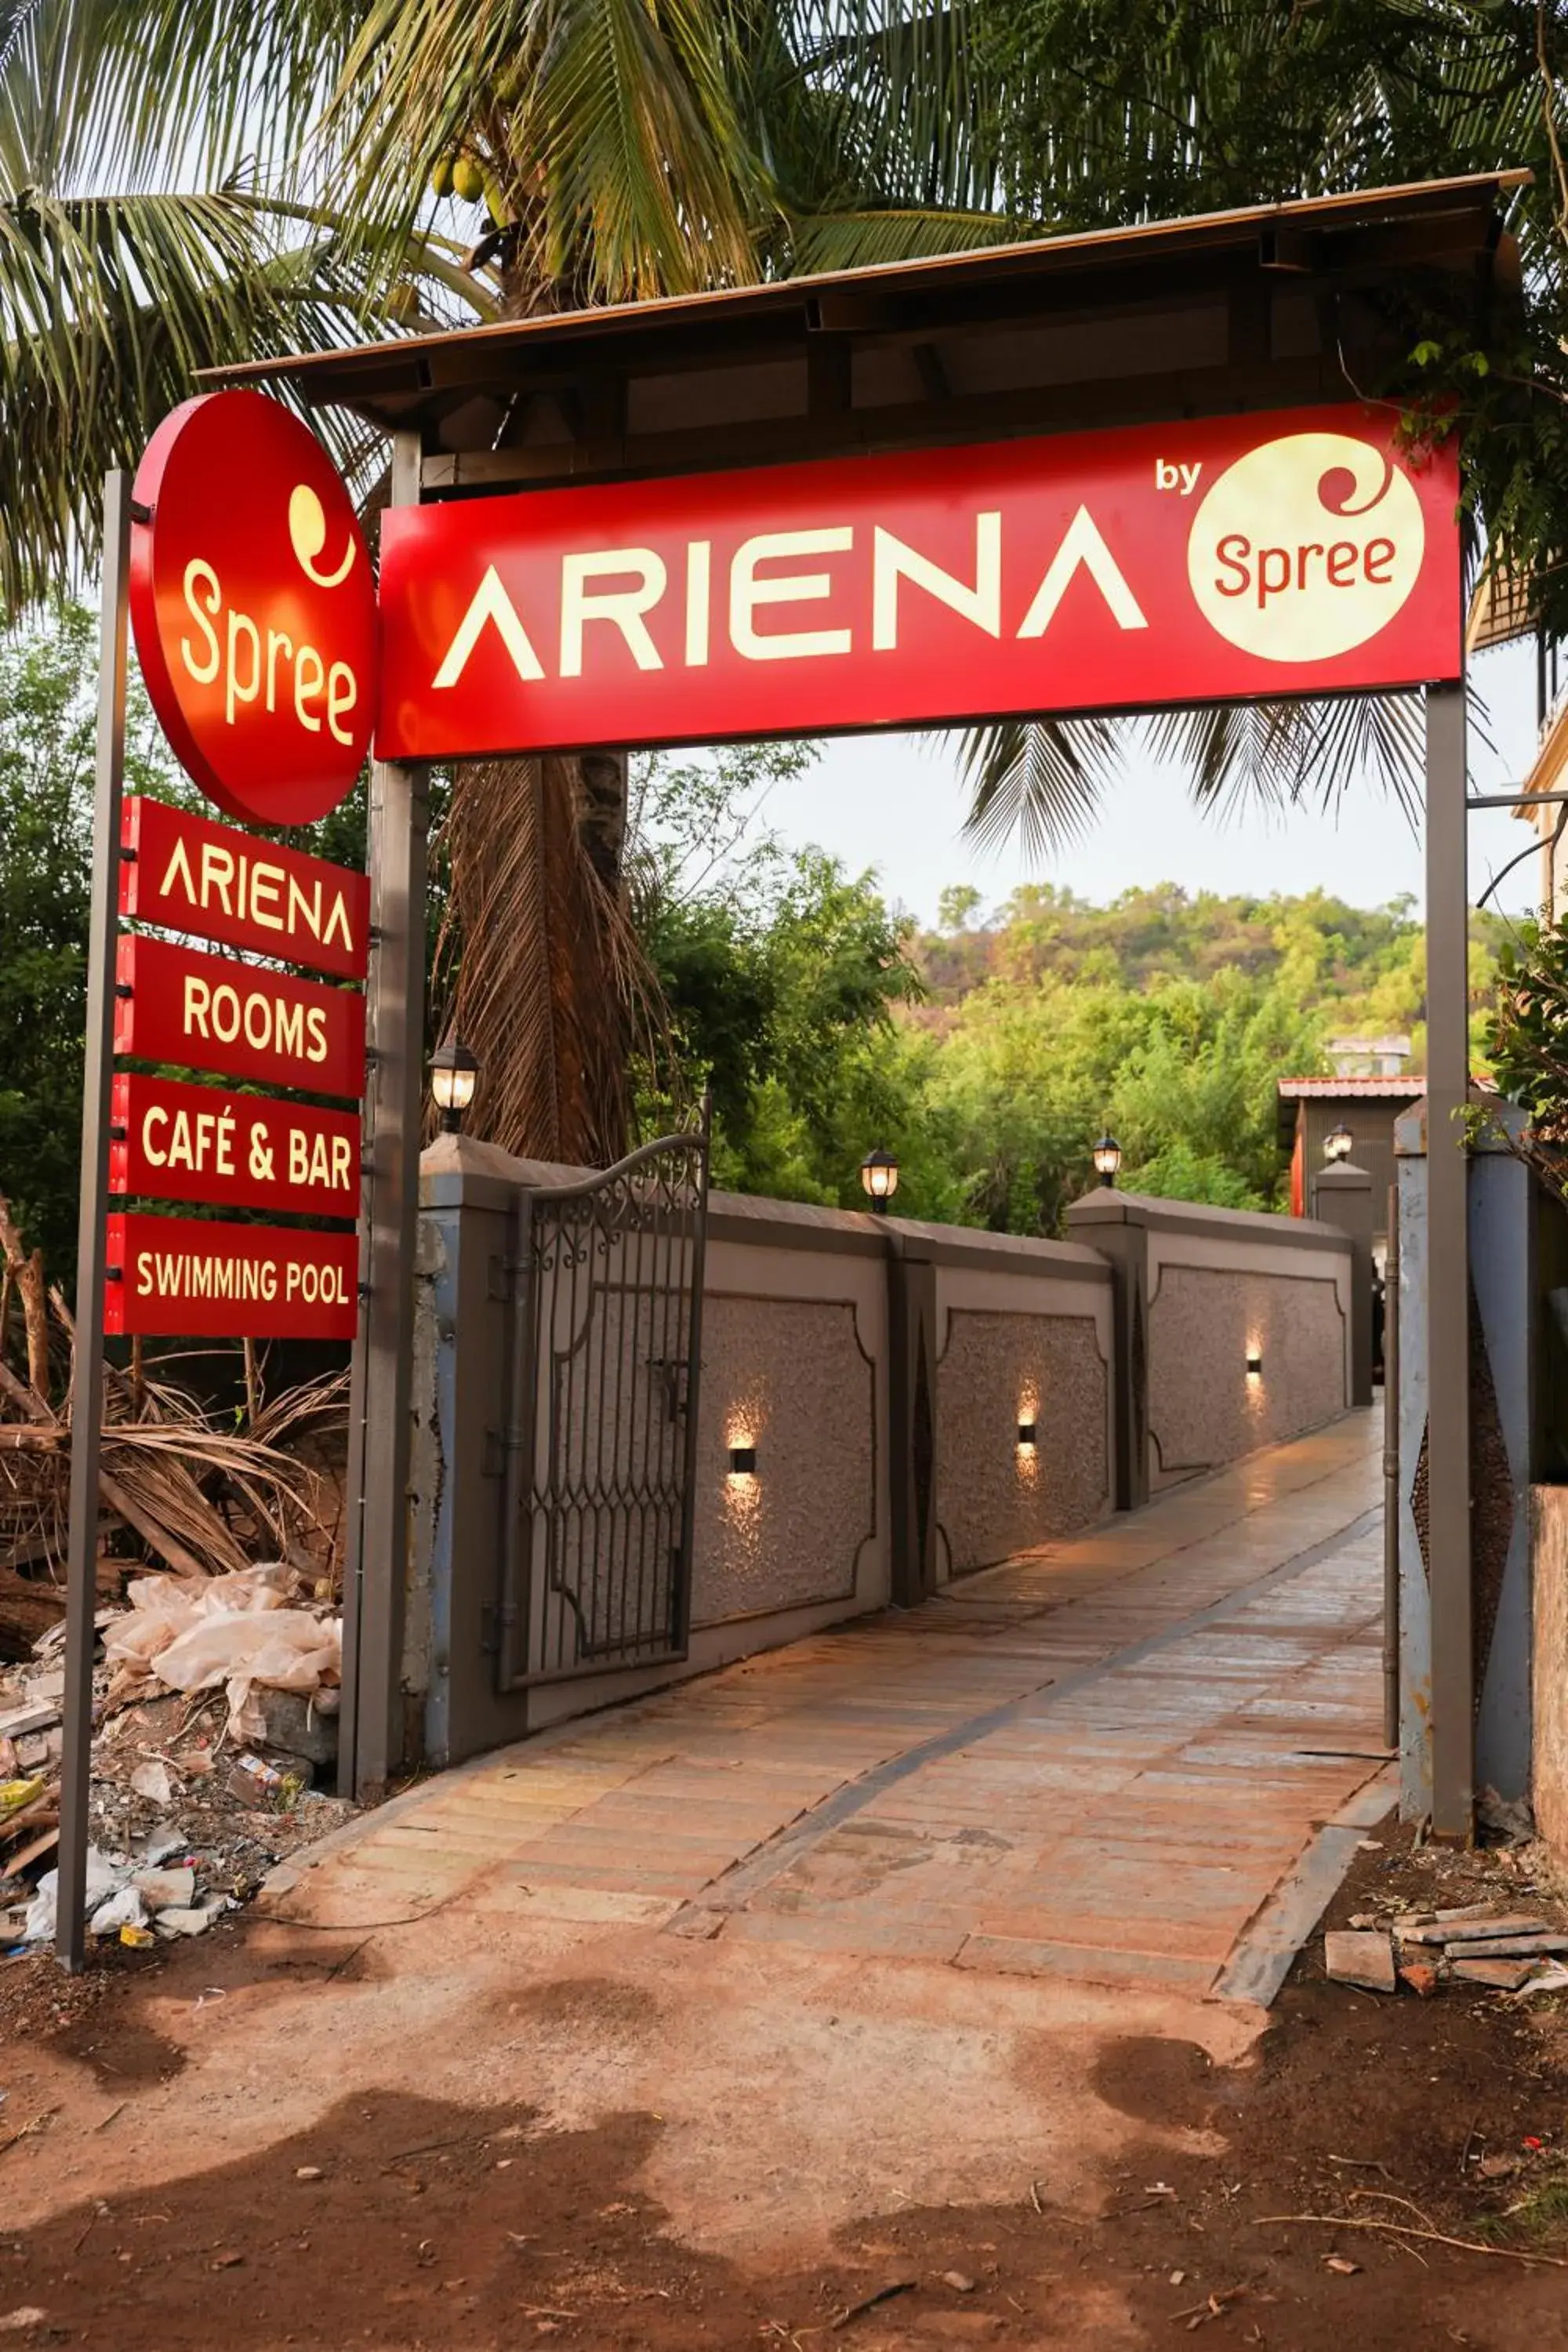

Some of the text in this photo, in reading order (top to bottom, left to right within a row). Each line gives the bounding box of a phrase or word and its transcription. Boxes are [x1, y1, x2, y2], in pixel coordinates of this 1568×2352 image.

[431, 459, 1397, 689] ARIENA by Spree
[181, 557, 358, 746] Spree
[159, 837, 354, 952] ARIENA
[183, 975, 328, 1063] ROOMS
[142, 1105, 351, 1191] CAFÉ & BAR
[136, 1251, 349, 1305] SWIMMING POOL
